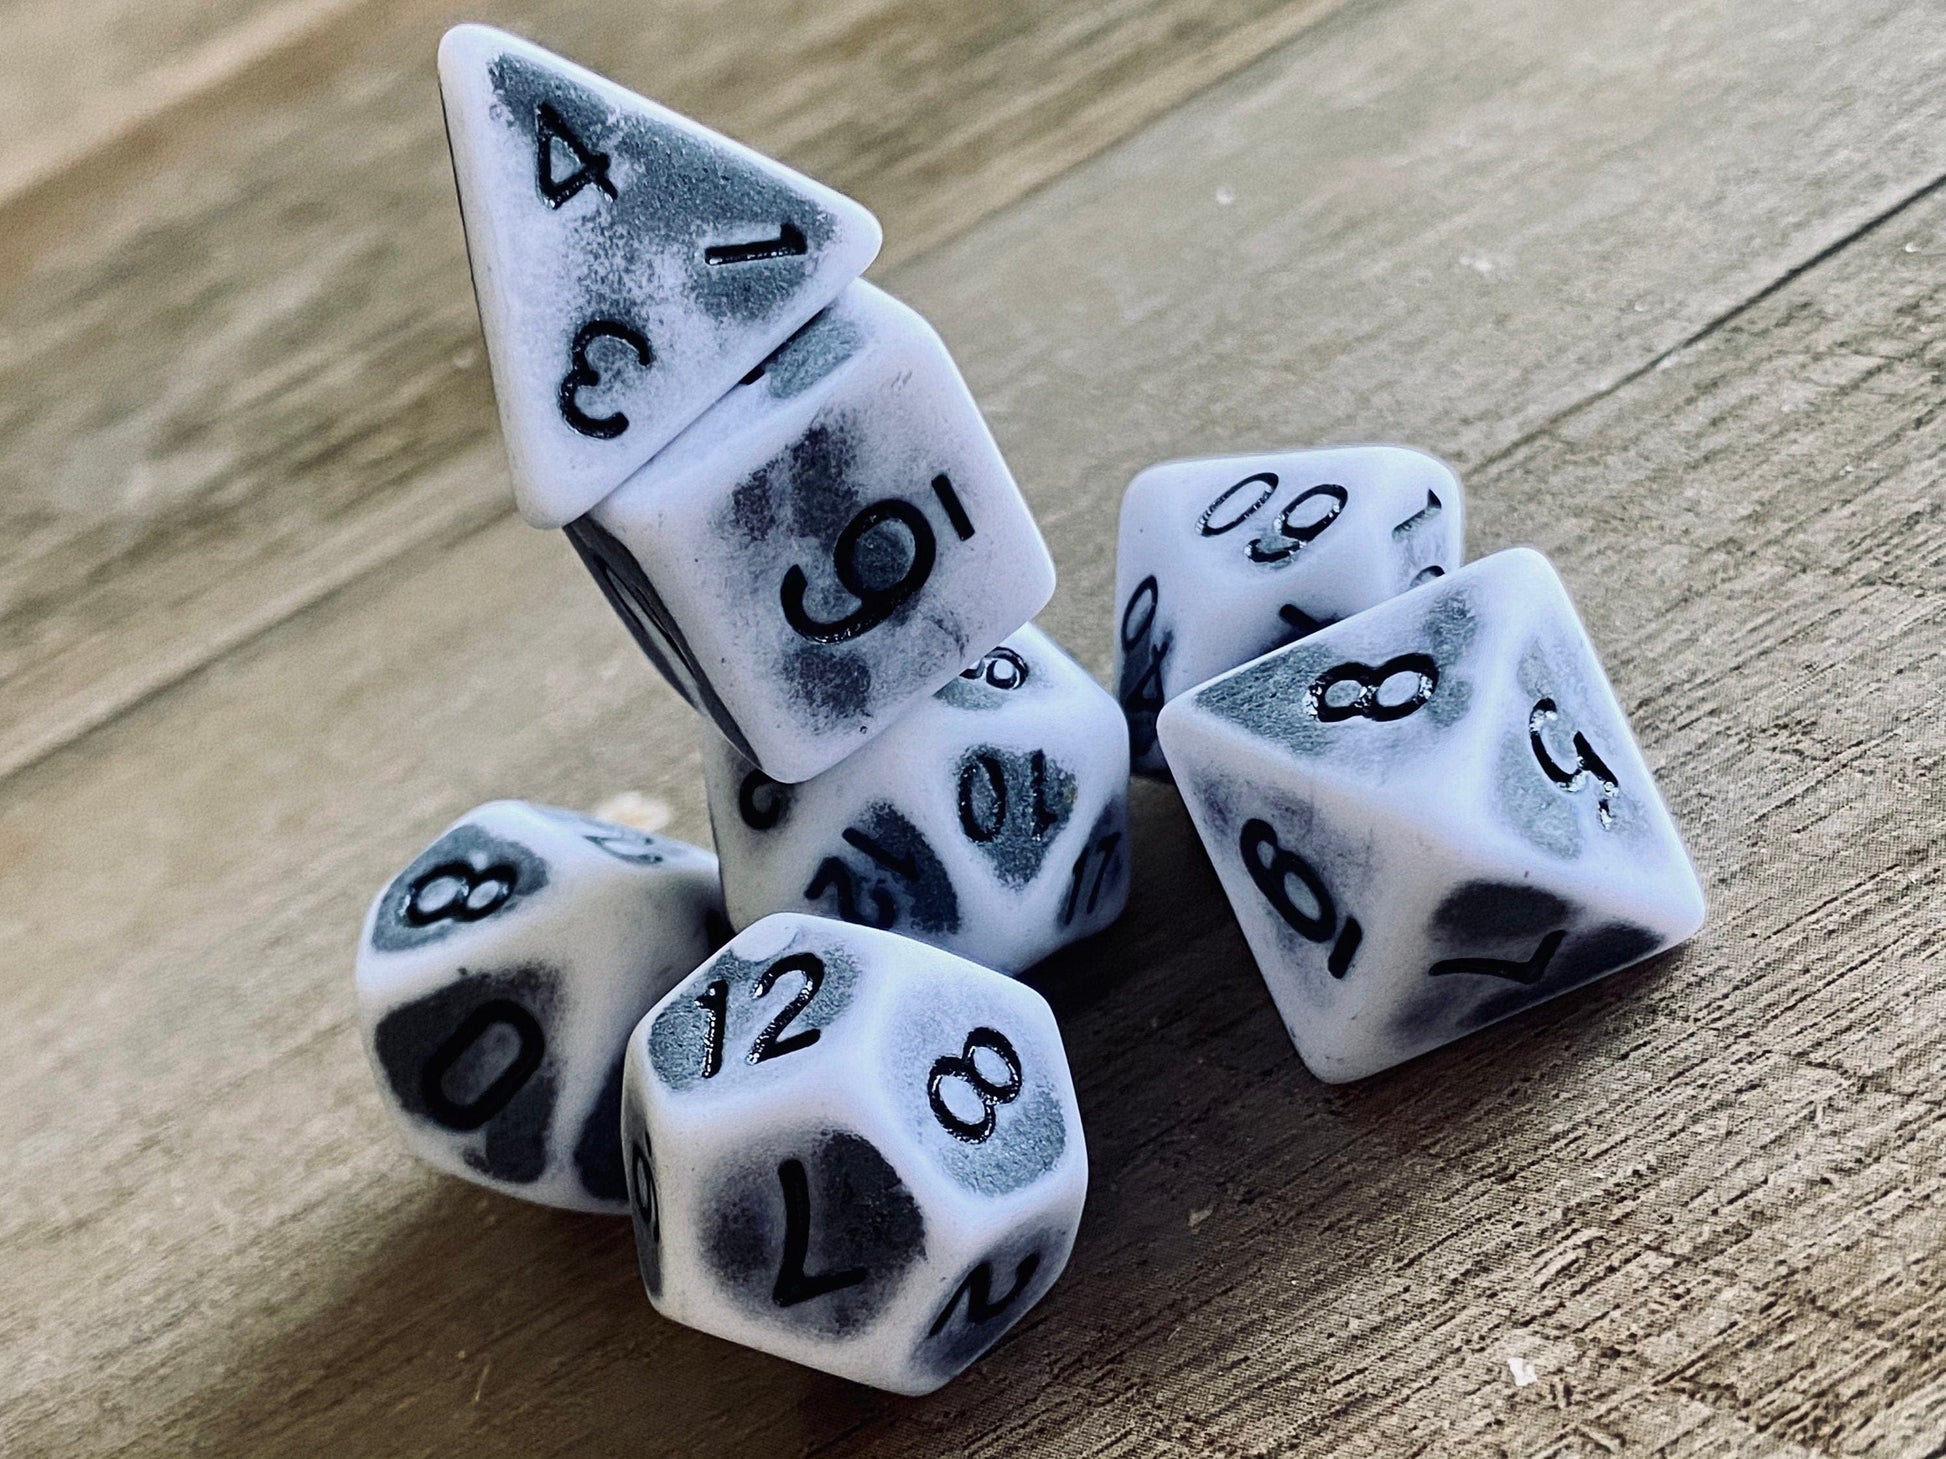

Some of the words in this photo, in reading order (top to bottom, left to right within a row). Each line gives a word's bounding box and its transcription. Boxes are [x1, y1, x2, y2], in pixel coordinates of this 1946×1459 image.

[535, 102, 617, 210] 4
[704, 223, 807, 265] 1
[560, 319, 651, 440] 3
[1307, 652, 1440, 724] 8
[958, 749, 1059, 843] 10
[404, 861, 518, 928] 8
[1428, 929, 1568, 985] 7
[698, 953, 826, 1078] 12
[422, 1000, 545, 1133] 0
[927, 1027, 1022, 1144] 8
[772, 1158, 869, 1308] 7
[926, 1250, 1042, 1339] 2
